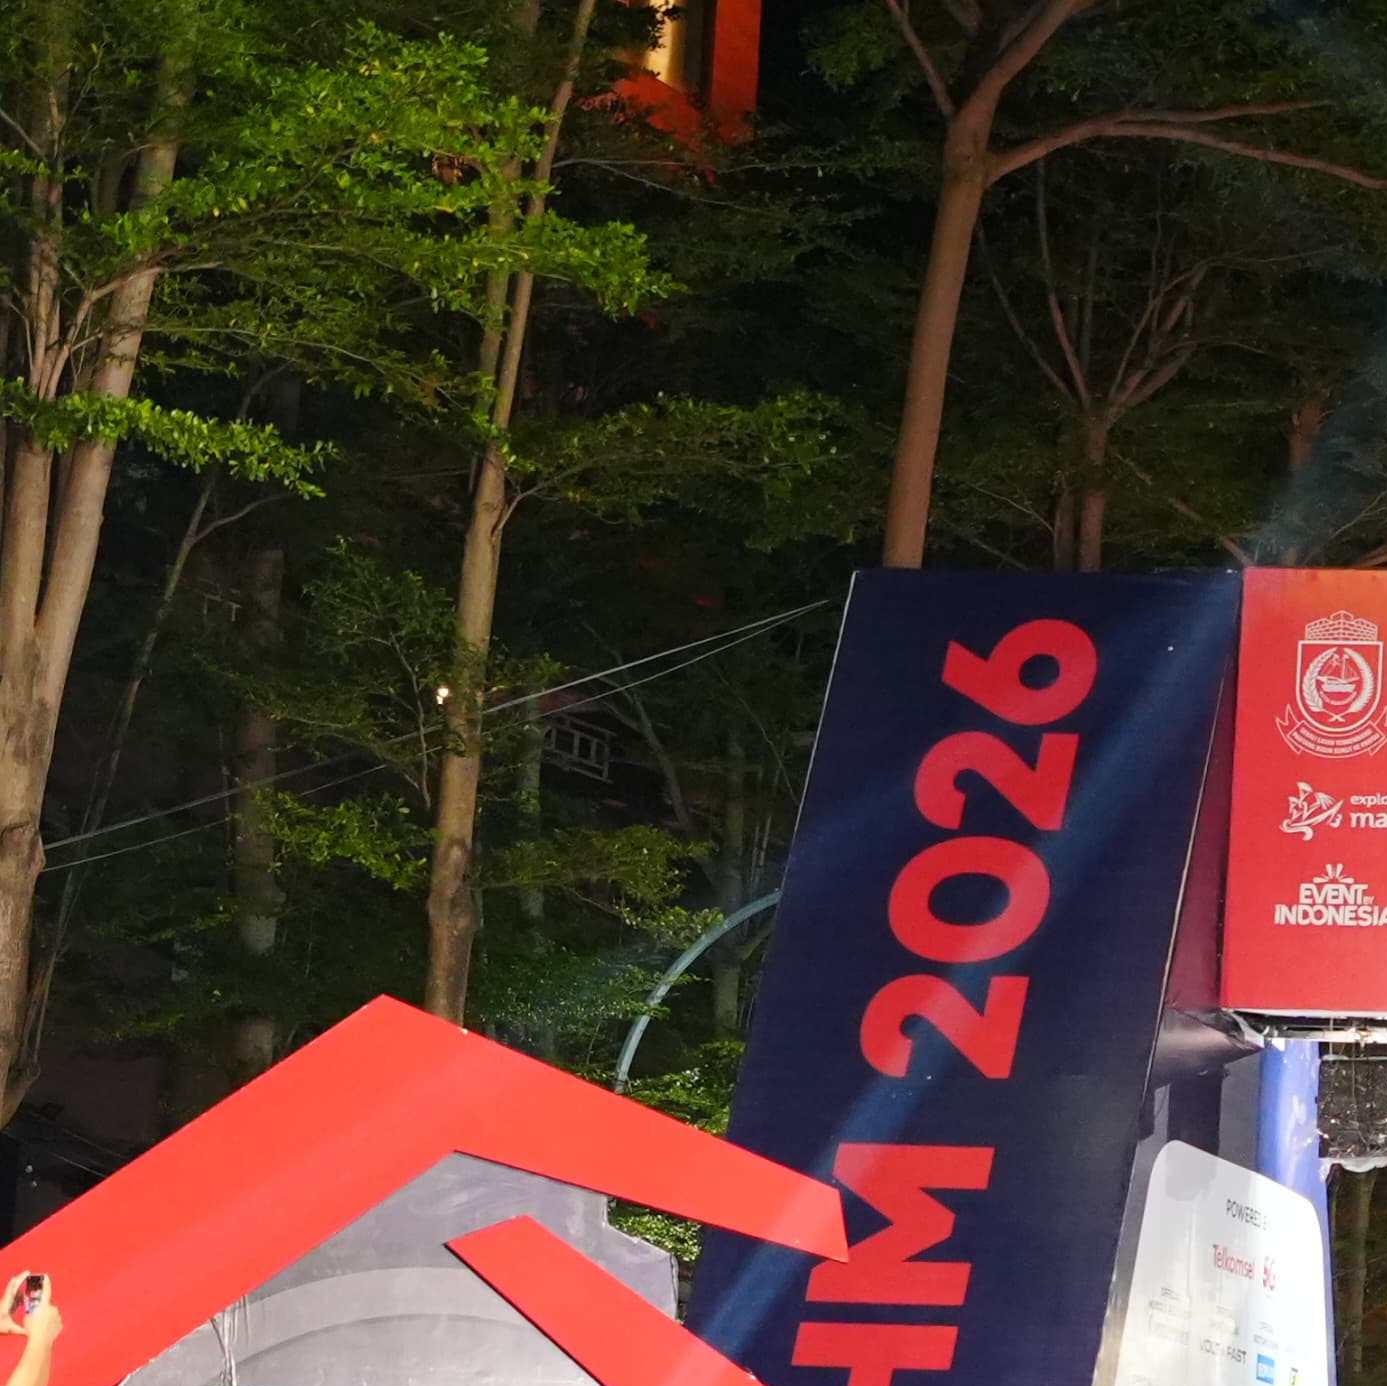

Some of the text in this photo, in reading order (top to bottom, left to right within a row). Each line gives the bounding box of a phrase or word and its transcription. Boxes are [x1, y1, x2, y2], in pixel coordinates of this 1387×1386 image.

[859, 618, 1097, 1079] 2026
[1299, 884, 1364, 905] EVENT
[1213, 1243, 1255, 1280] Telkomsel
